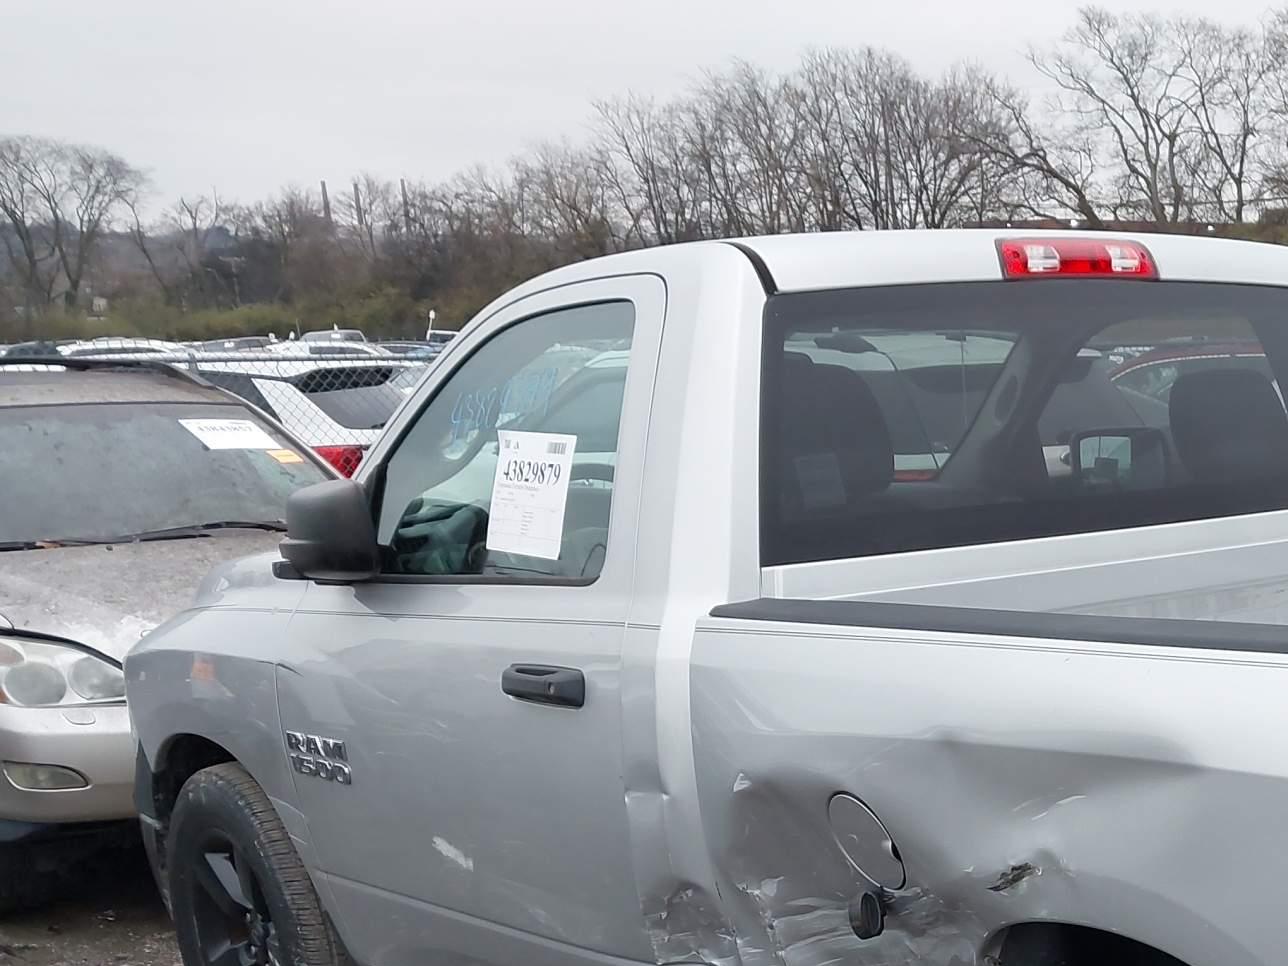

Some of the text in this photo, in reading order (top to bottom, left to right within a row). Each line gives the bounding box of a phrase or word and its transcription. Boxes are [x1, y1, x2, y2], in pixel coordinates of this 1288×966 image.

[503, 459, 561, 487] 43829879
[285, 729, 348, 761] RAM
[289, 752, 352, 785] 1500
